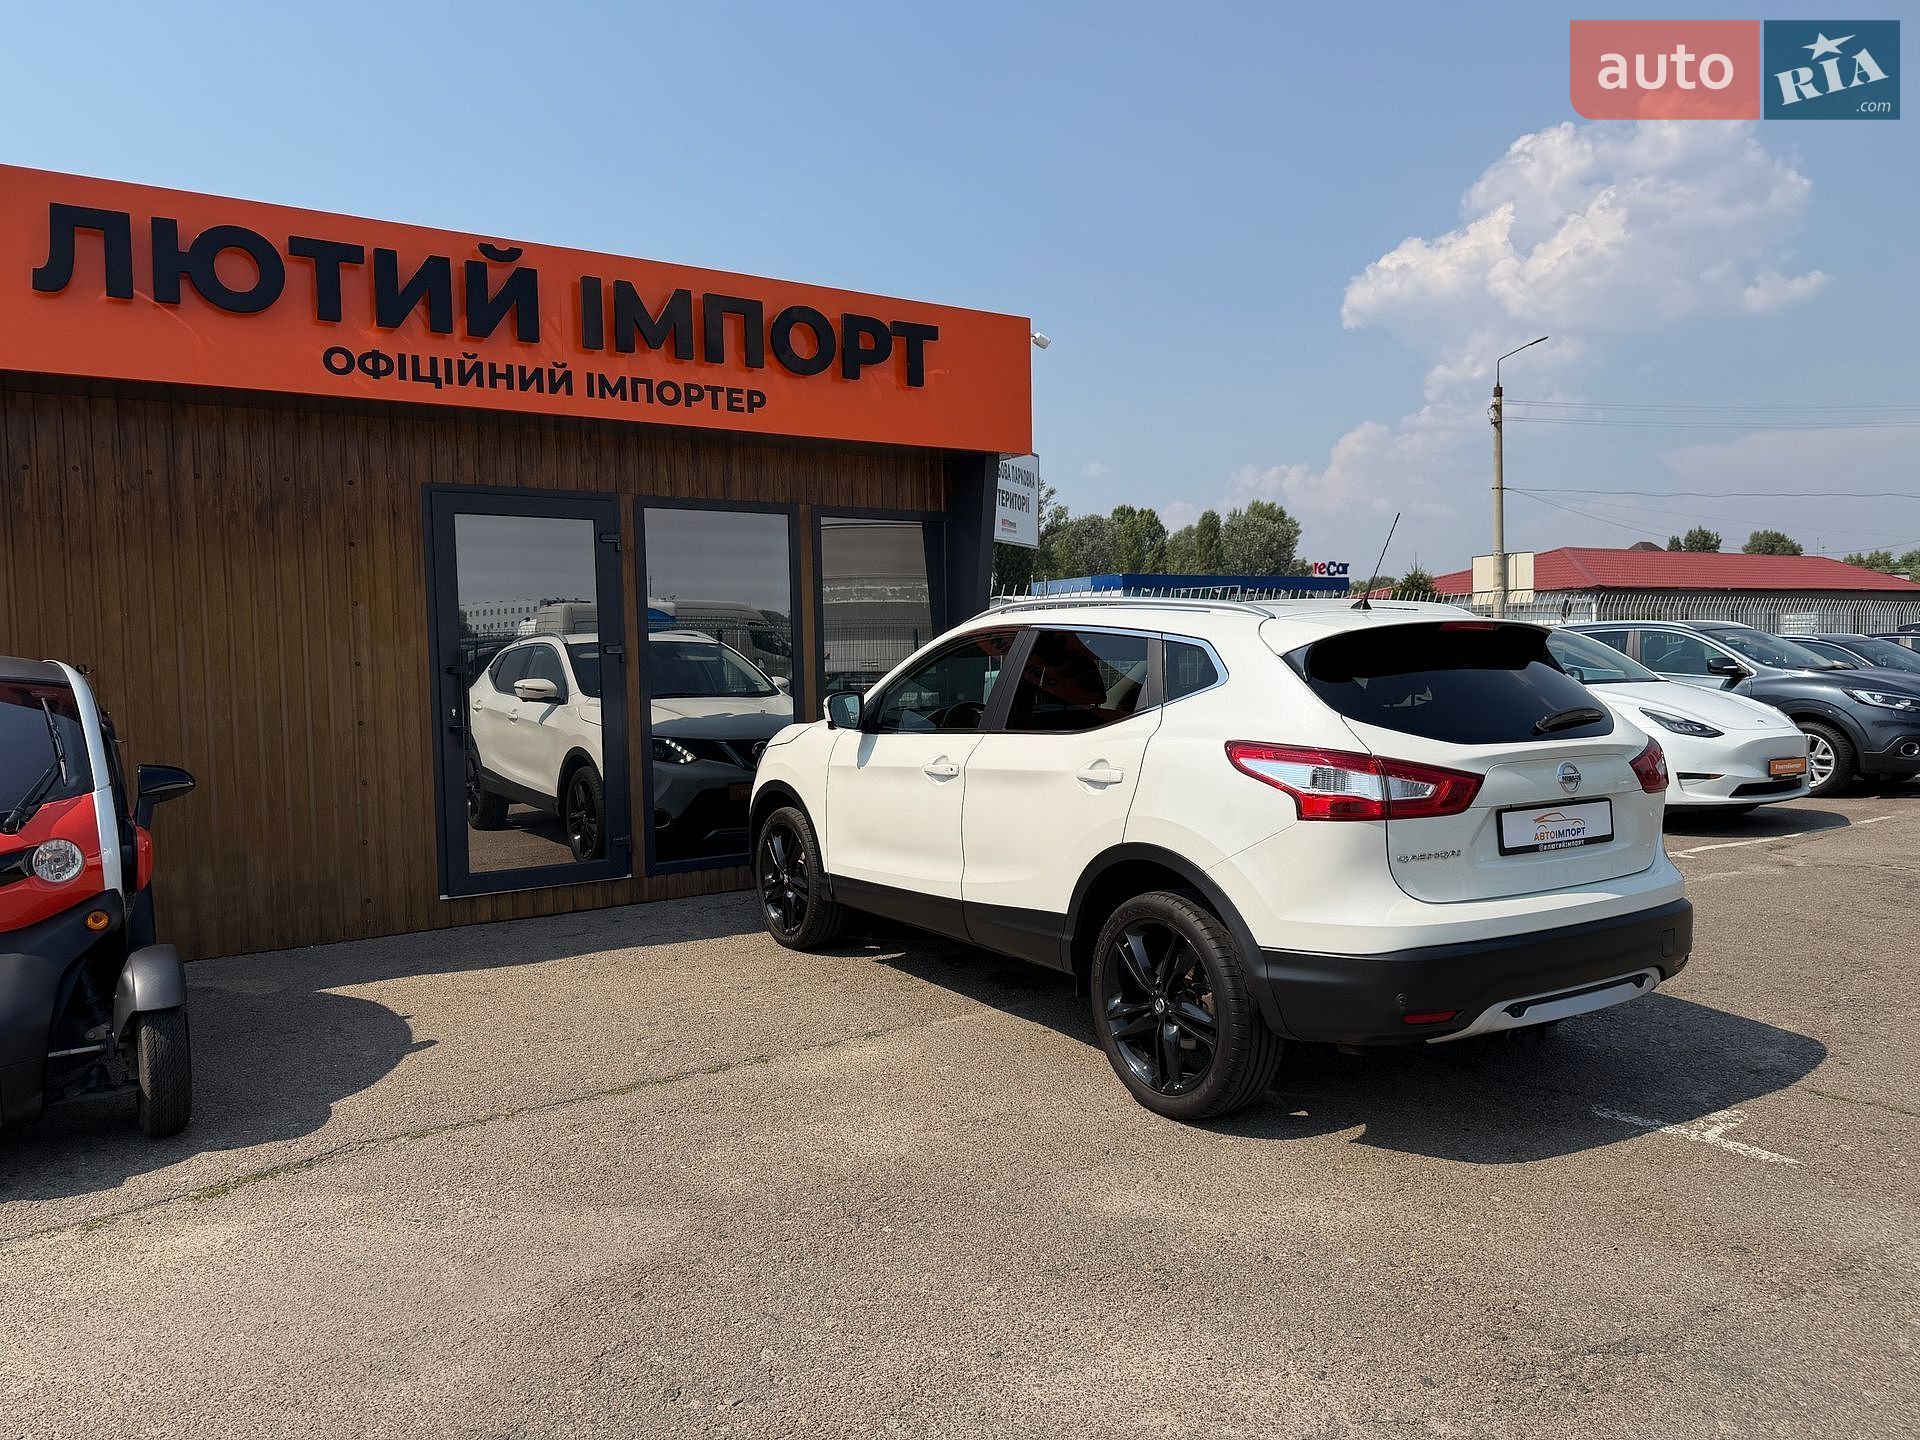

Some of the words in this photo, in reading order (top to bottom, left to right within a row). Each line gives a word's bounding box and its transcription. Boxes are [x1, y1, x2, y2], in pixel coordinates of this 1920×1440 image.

[32, 203, 541, 344] ЛЮТИЙ
[580, 276, 939, 388] ІМПОРТ
[322, 346, 574, 396] ОФІЦІЙНИЙ
[586, 372, 767, 414] ІМПОРТЕР
[998, 488, 1031, 514] ТЕРИТОРІЇ
[1534, 826, 1586, 841] АВТОІМПОРТ
